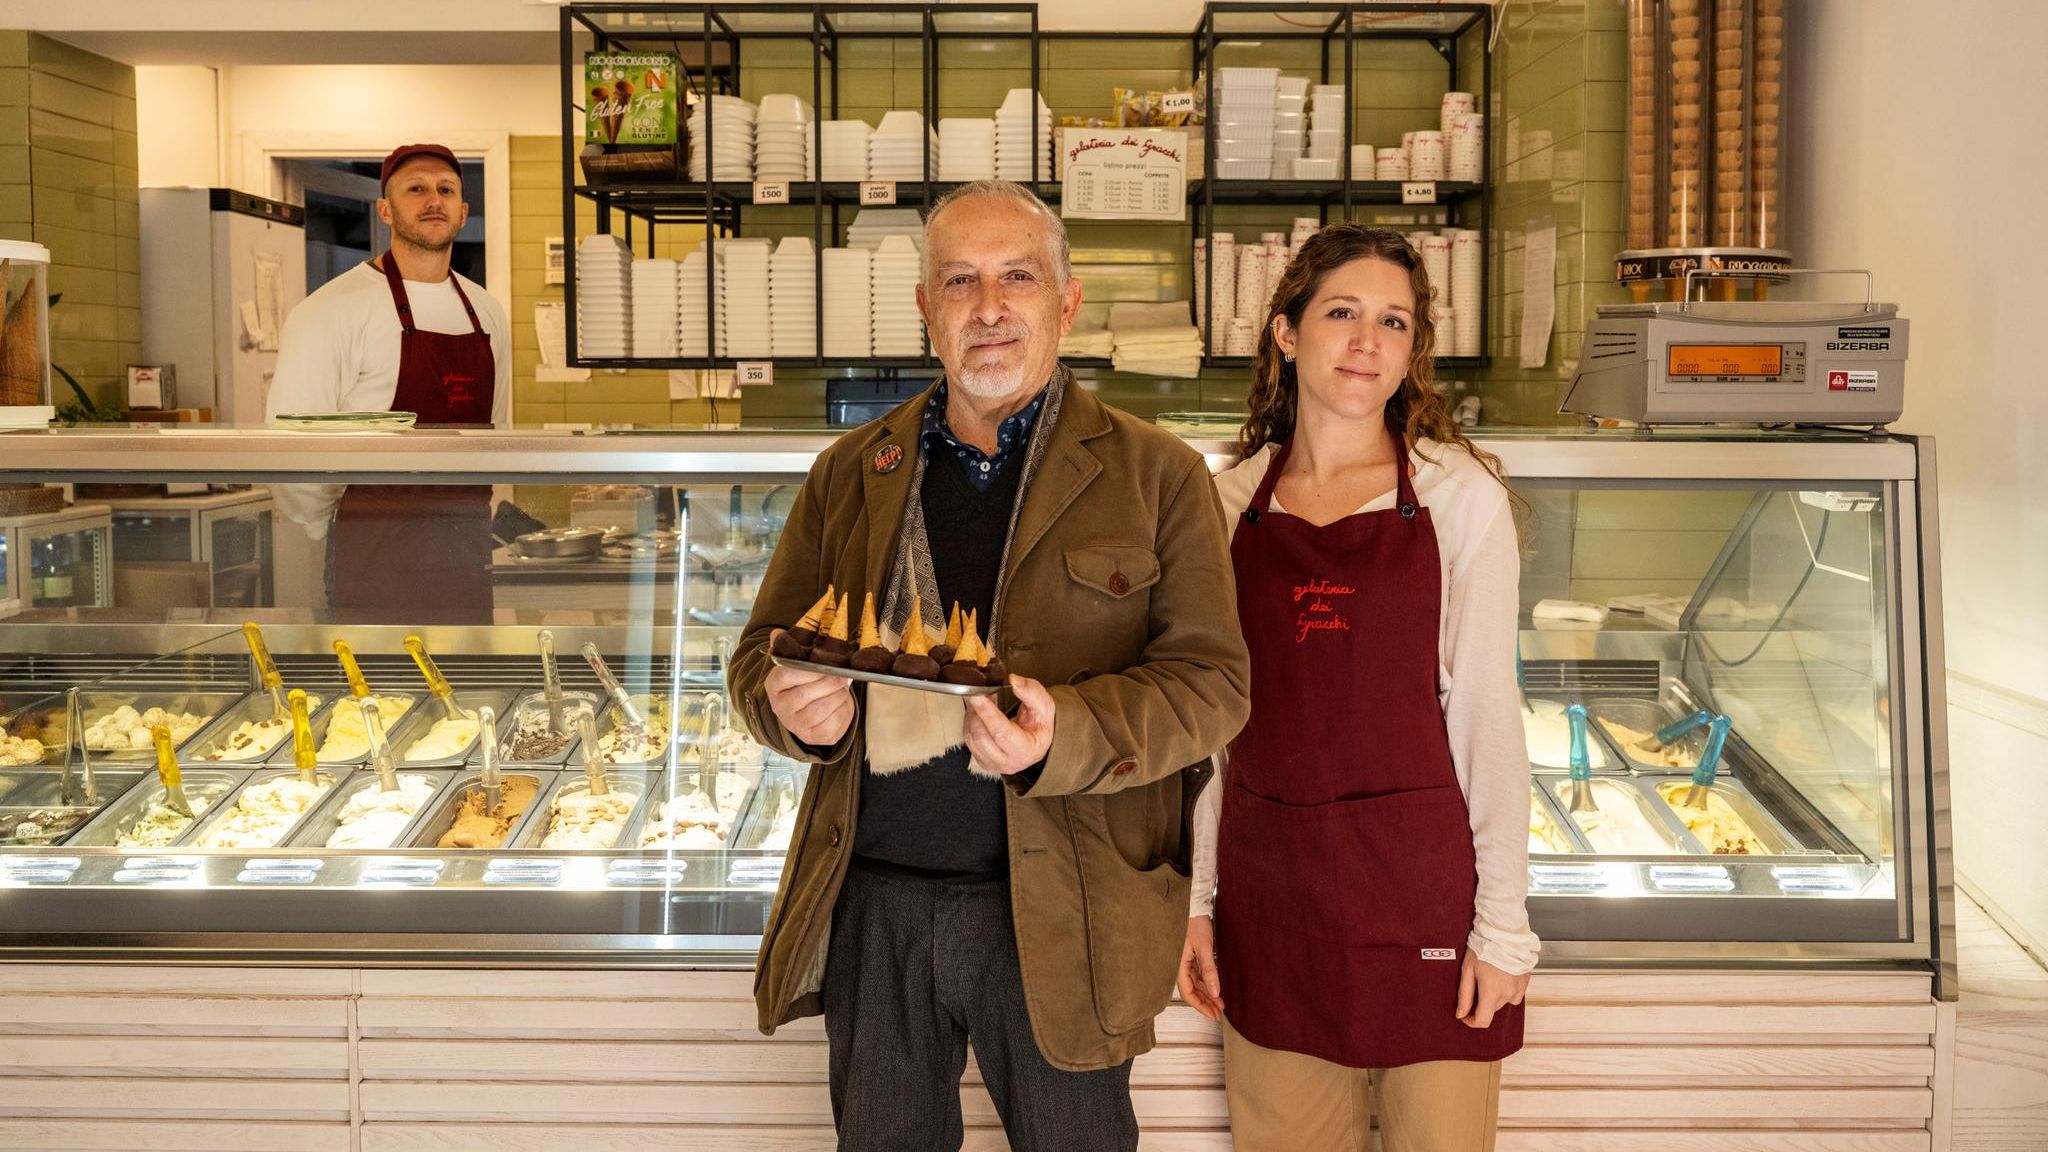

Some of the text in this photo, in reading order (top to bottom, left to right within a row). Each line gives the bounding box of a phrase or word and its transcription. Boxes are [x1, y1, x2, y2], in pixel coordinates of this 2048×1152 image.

[590, 93, 664, 122] Gluten Free
[631, 116, 666, 128] CONI
[1069, 135, 1181, 163] gelateria dei Gracchi
[761, 190, 782, 199] 1500
[868, 191, 889, 200] 1000
[1407, 189, 1432, 197] € 4,80
[1826, 342, 1889, 351] BIZERBA
[747, 371, 763, 380] 350
[1294, 579, 1356, 602] gelateria
[1309, 597, 1334, 612] dei
[1295, 612, 1351, 643] Gracchi
